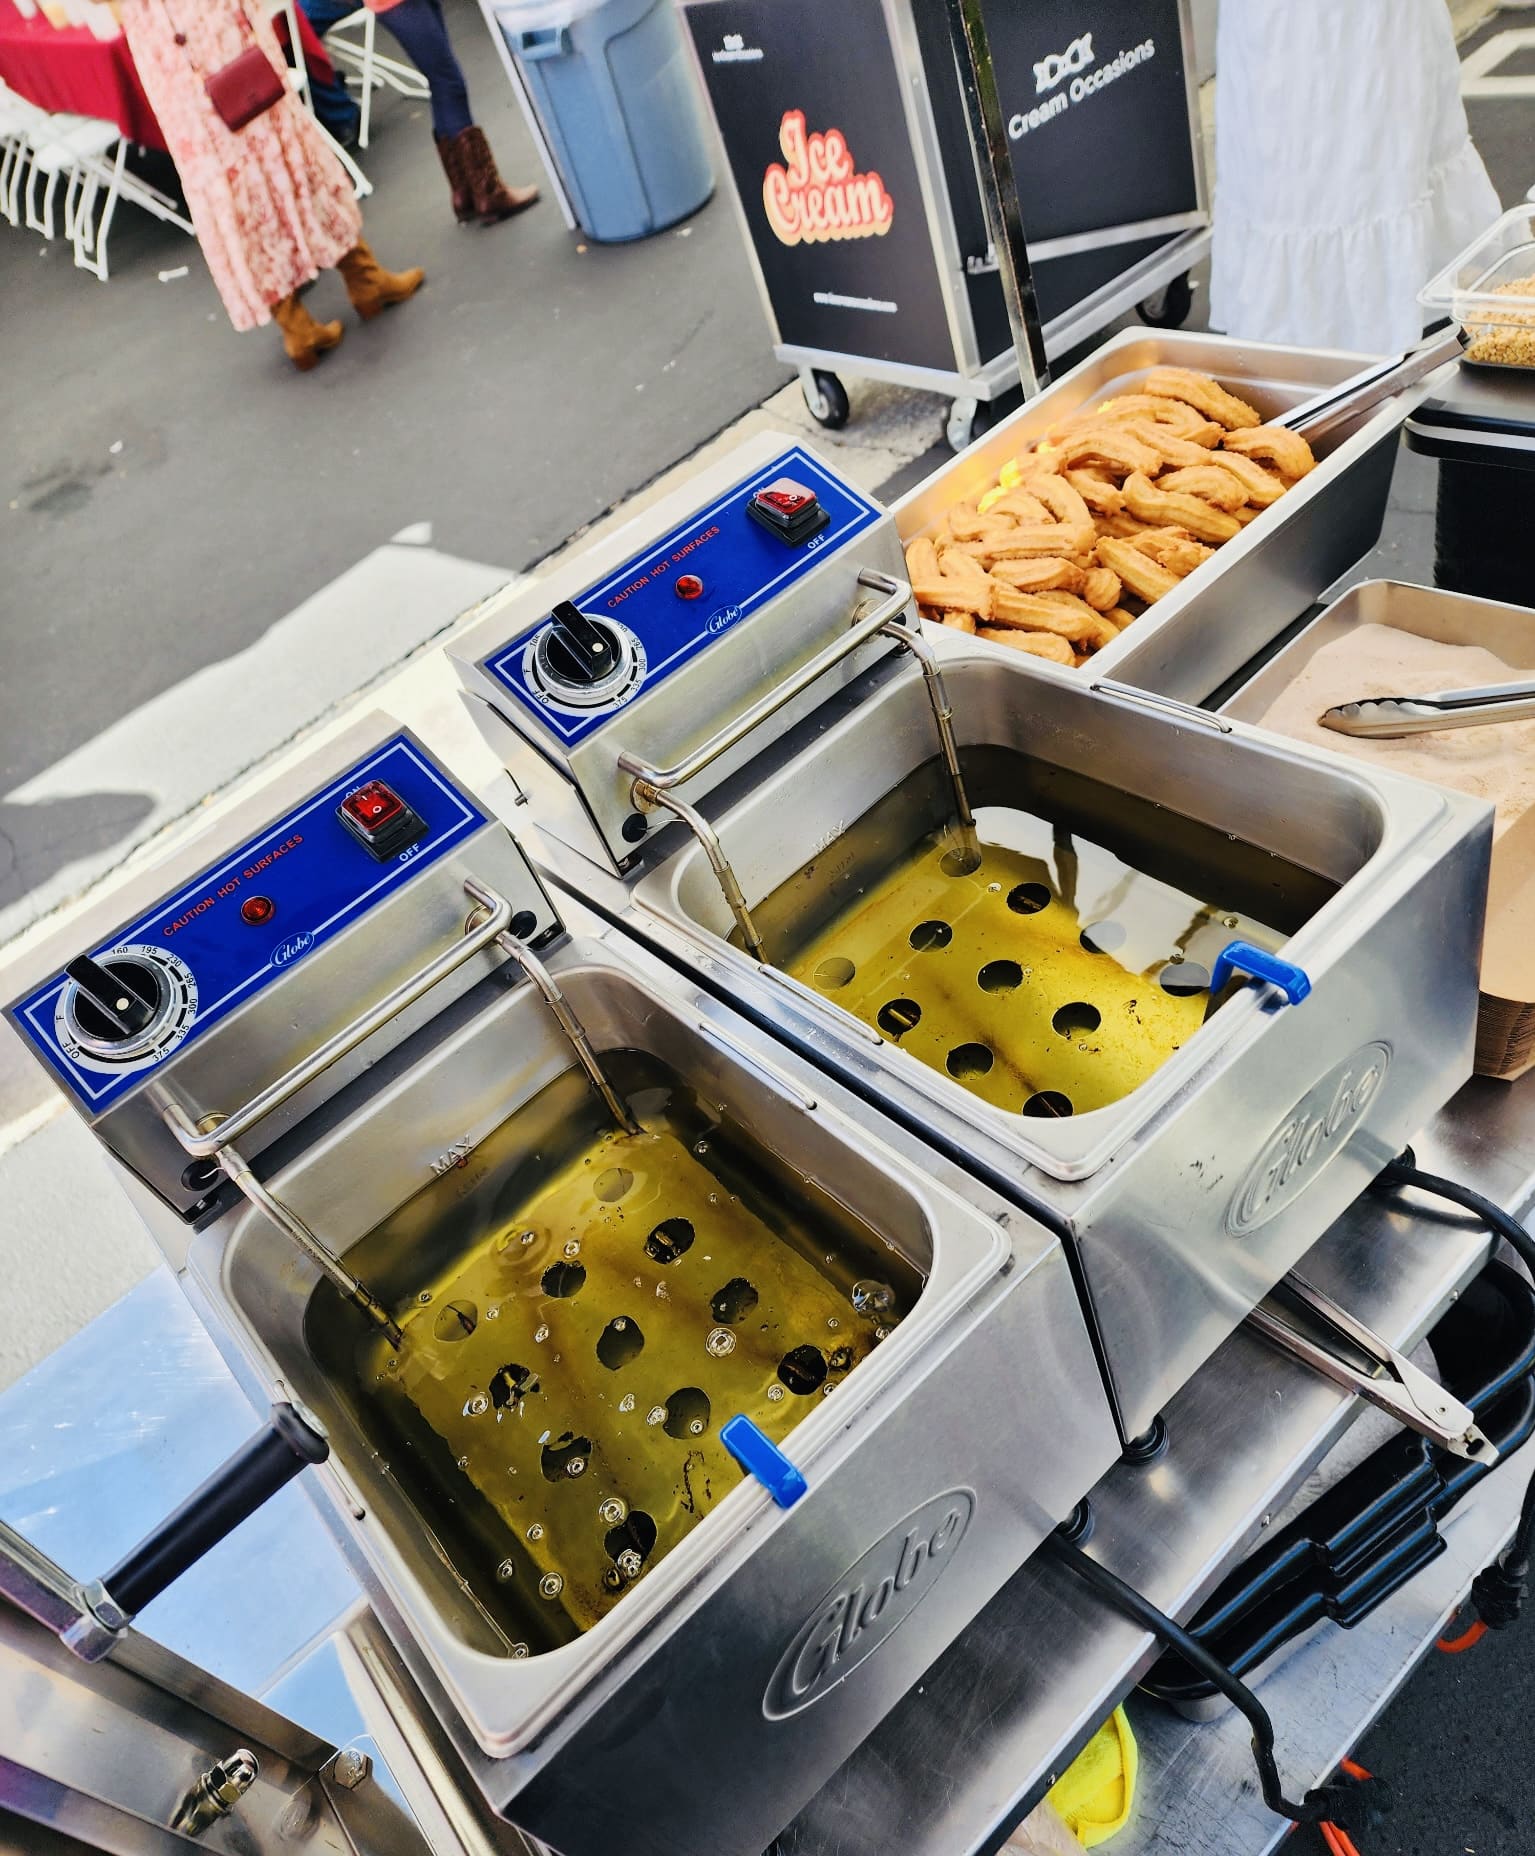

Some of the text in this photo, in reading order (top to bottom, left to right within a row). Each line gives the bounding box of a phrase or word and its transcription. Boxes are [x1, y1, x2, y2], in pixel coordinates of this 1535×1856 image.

[1008, 38, 1155, 140] Cream Occasions
[780, 112, 851, 187] Ice
[765, 167, 891, 239] Cream
[807, 534, 825, 549] OFF
[607, 526, 720, 608] CAUTION HOT SURFACES
[709, 606, 739, 633] Globe
[631, 679, 641, 692] 335
[612, 697, 628, 708] 375
[399, 842, 420, 862] OFF
[163, 834, 304, 936] CAUTION HOT SURFACES
[112, 946, 128, 955] 160
[140, 946, 157, 955] 195
[274, 933, 311, 965] Globe
[166, 954, 182, 967] 230
[184, 972, 196, 989] 265
[187, 998, 198, 1014] 300
[176, 1024, 190, 1040] 335
[62, 1042, 80, 1059] OFF
[152, 1047, 170, 1061] 375
[1239, 1065, 1379, 1225] Globe
[789, 1507, 962, 1696] Globe
